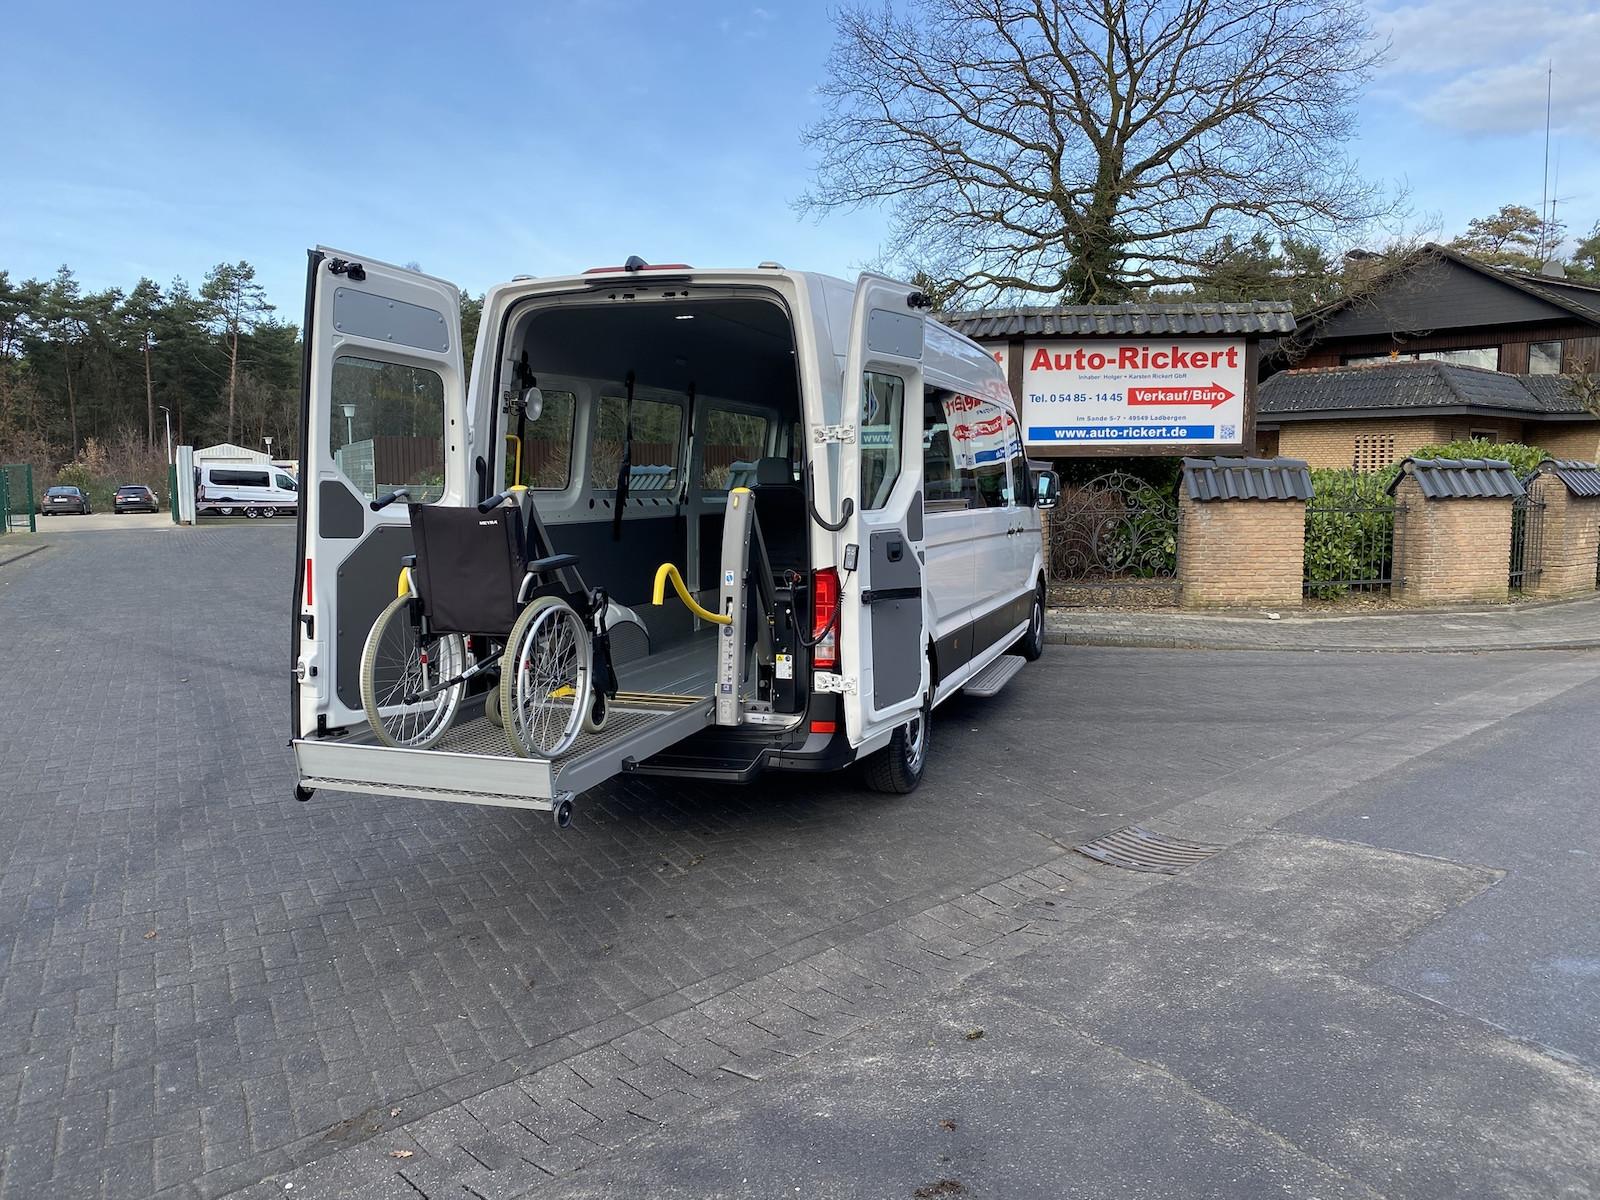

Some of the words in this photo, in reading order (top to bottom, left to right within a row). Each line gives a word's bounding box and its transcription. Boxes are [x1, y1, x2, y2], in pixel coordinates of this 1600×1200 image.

[1030, 345, 1238, 371] Auto-Rickert
[1029, 394, 1048, 403] Tel.
[1135, 389, 1226, 402] Verkauf/Büro
[1150, 414, 1187, 422] Ladbergen
[1054, 426, 1187, 438] www.auto-rickert.de
